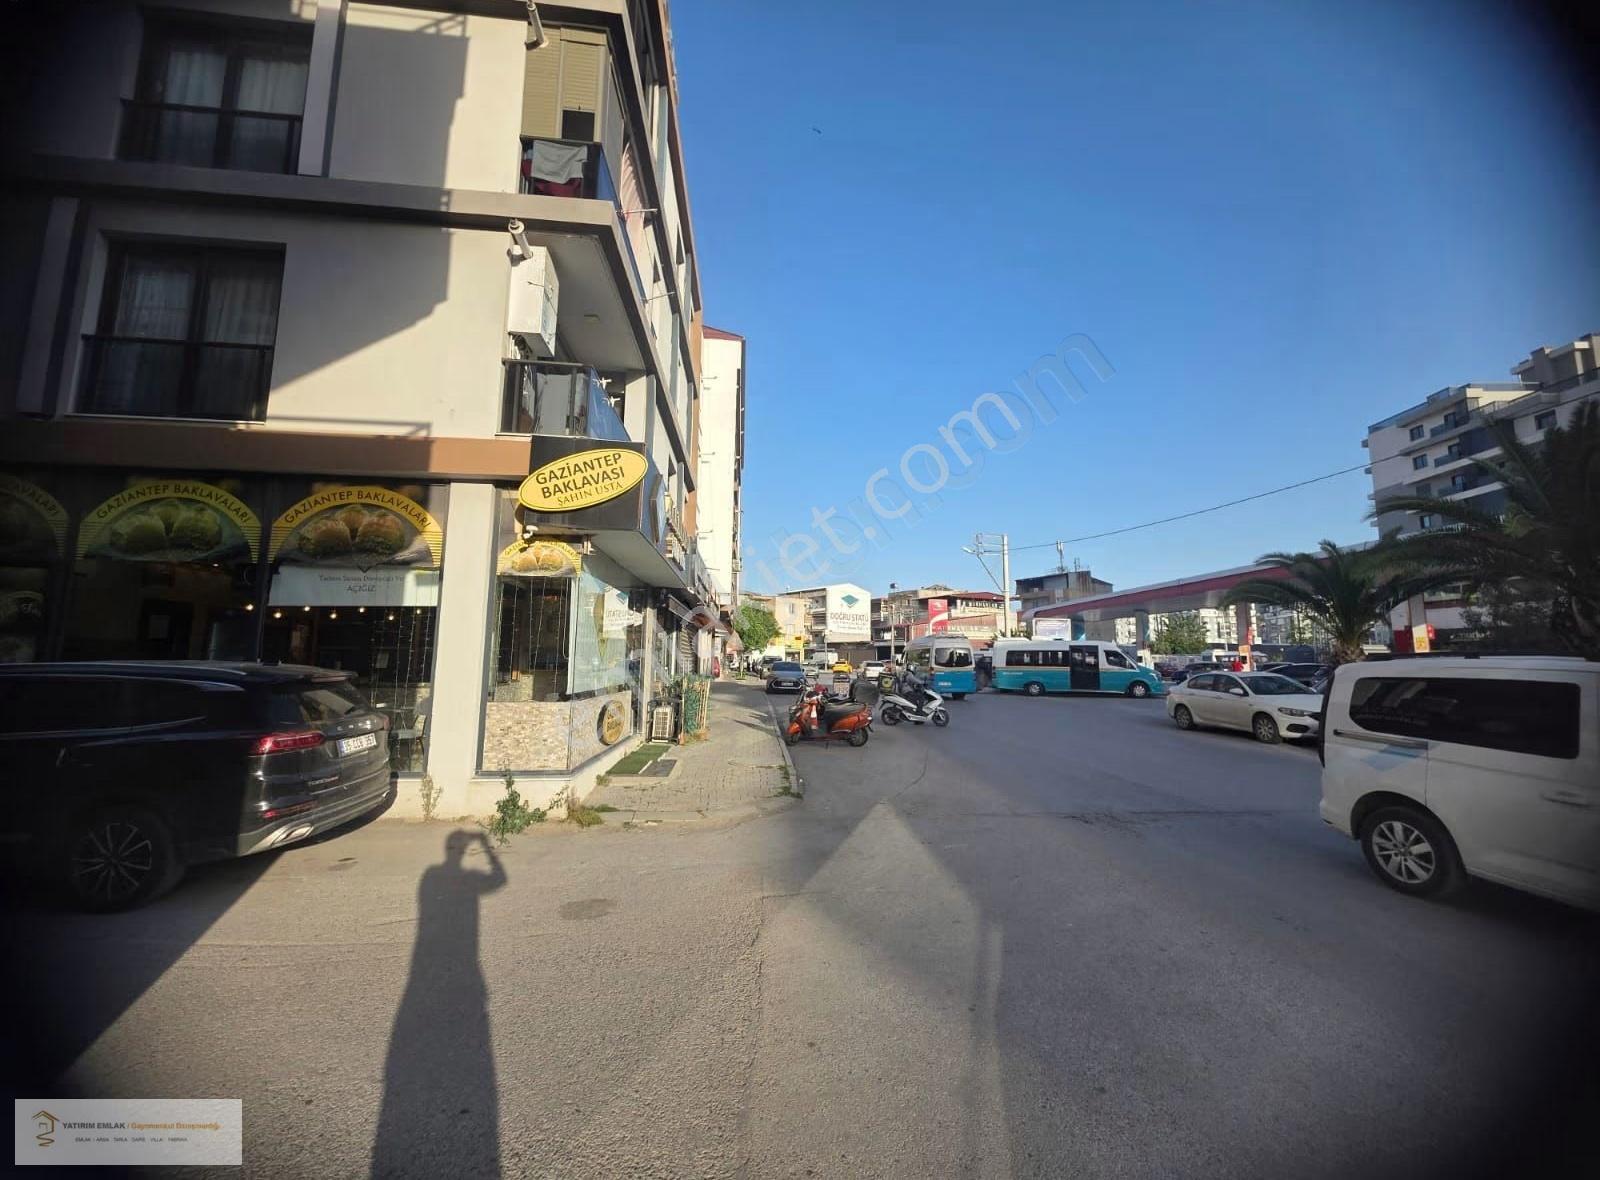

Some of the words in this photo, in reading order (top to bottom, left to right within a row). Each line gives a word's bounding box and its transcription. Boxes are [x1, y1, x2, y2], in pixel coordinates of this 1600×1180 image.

[535, 453, 622, 485] GAZİANTEP
[541, 467, 625, 499] BAKLAVASI
[174, 484, 250, 523] BAKLAVALARI
[595, 482, 623, 495] USTA
[357, 490, 432, 528] BAKLAVALARI
